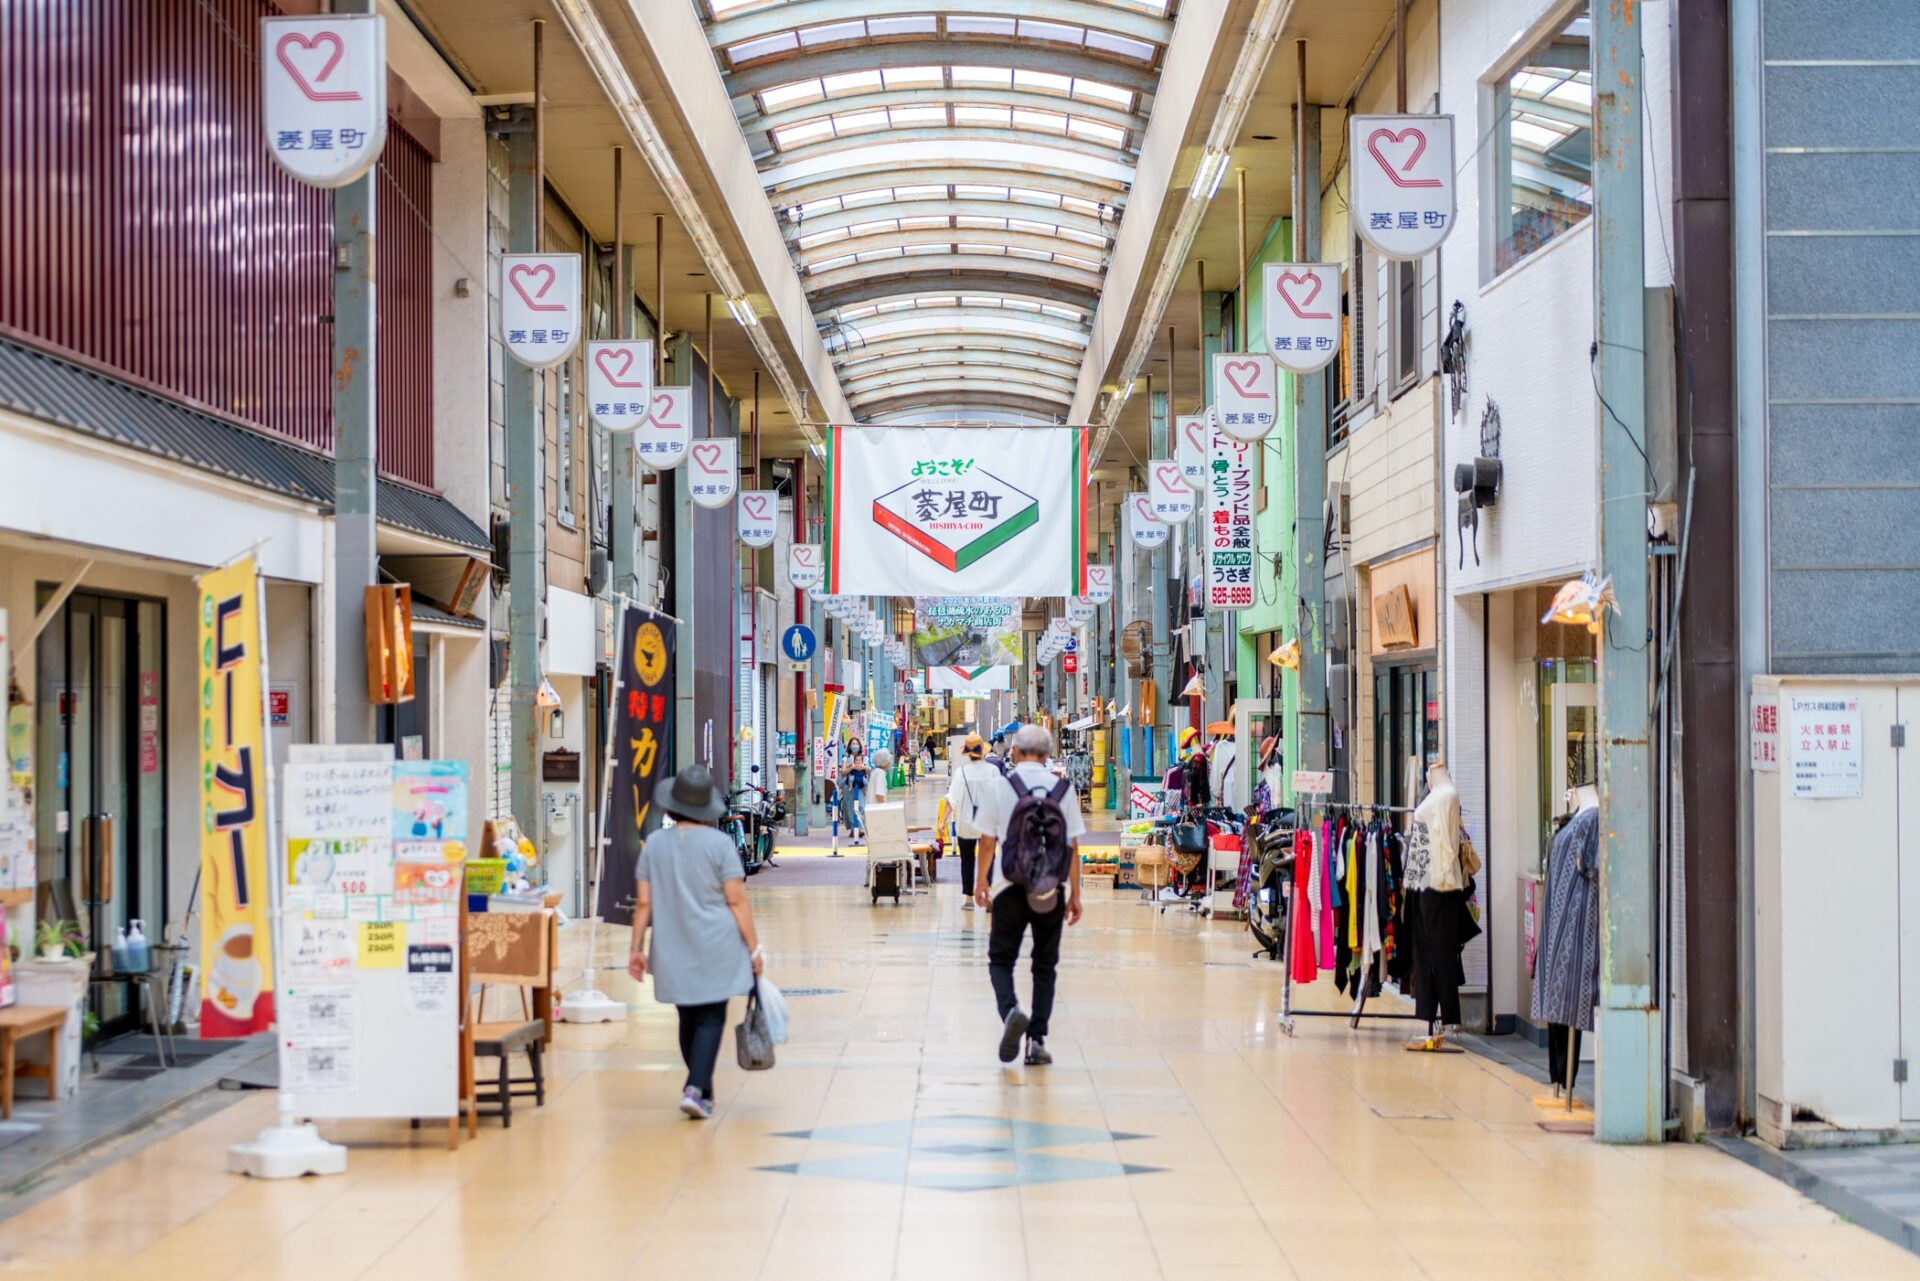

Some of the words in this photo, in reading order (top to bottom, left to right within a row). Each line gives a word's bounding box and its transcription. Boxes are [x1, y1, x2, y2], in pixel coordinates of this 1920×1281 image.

[277, 128, 366, 151] 菱屋町
[1370, 211, 1447, 230] 菱屋町
[509, 329, 570, 344] 菱屋町
[1274, 336, 1334, 351] 菱屋町
[595, 403, 645, 416] 菱屋町
[1224, 413, 1273, 425] 菱屋町
[639, 441, 684, 453] 菱屋町
[692, 484, 730, 495] 菱屋町
[912, 488, 1002, 522] 菱屋町
[929, 522, 983, 530] HISHIYA-CHO
[1213, 567, 1251, 583] うさぎ
[1801, 724, 1850, 736] 火気厳禁
[1801, 739, 1850, 751] 立入禁止
[630, 728, 658, 848] カレ
